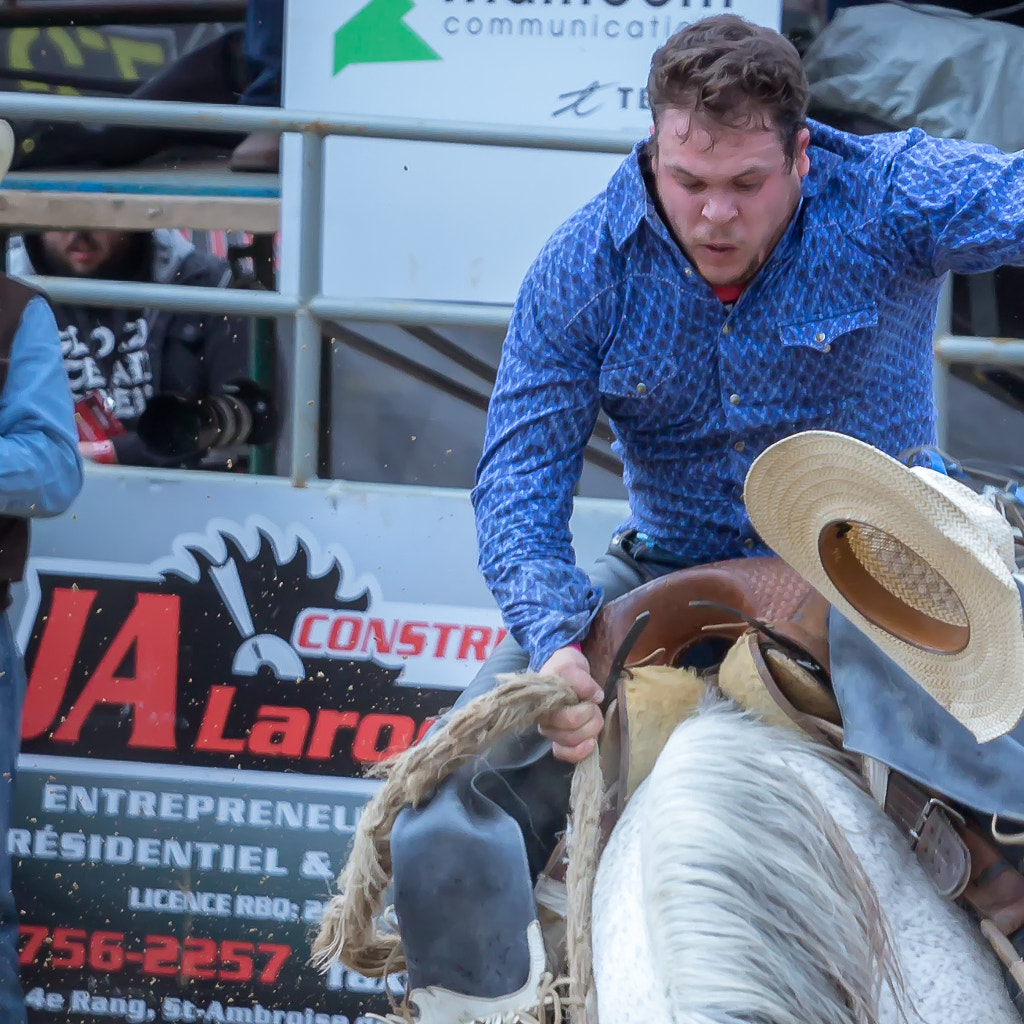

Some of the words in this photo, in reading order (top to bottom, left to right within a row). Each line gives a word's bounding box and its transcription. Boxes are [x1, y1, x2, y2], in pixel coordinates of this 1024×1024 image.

[20, 587, 182, 750] JA
[7, 826, 289, 877] RÉSIDENTIEL
[301, 850, 335, 880] &
[128, 886, 231, 917] LICENCE
[18, 924, 292, 985] 756-2257
[24, 987, 64, 1011] 4e
[69, 989, 156, 1024] Rang,
